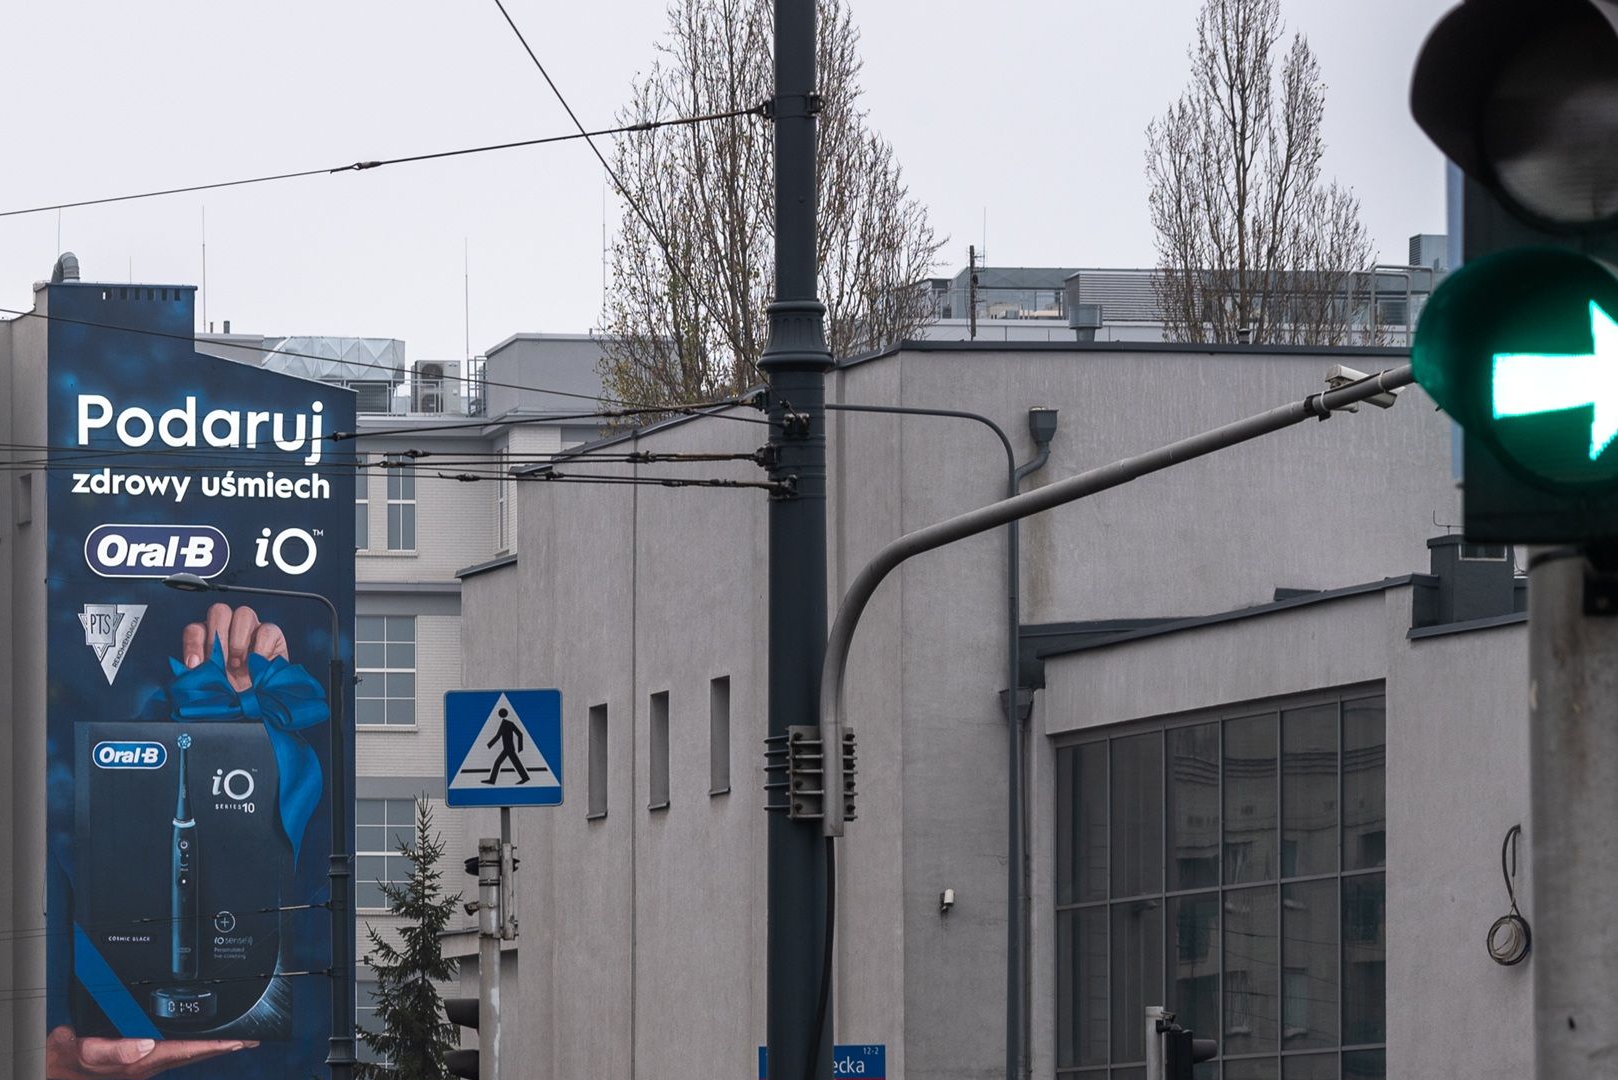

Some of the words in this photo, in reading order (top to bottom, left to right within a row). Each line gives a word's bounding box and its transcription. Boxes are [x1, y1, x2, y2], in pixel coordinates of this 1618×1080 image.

[77, 394, 324, 466] Podaruj
[71, 468, 191, 502] zdrowy
[201, 470, 330, 499] uśmiech
[96, 533, 215, 568] Oral-B
[90, 613, 111, 635] PTS
[111, 616, 140, 668] REKOMENDACJA
[98, 746, 159, 764] Oral-B
[212, 768, 255, 801] iO
[242, 802, 255, 814] 10
[833, 1056, 865, 1074] ecka
